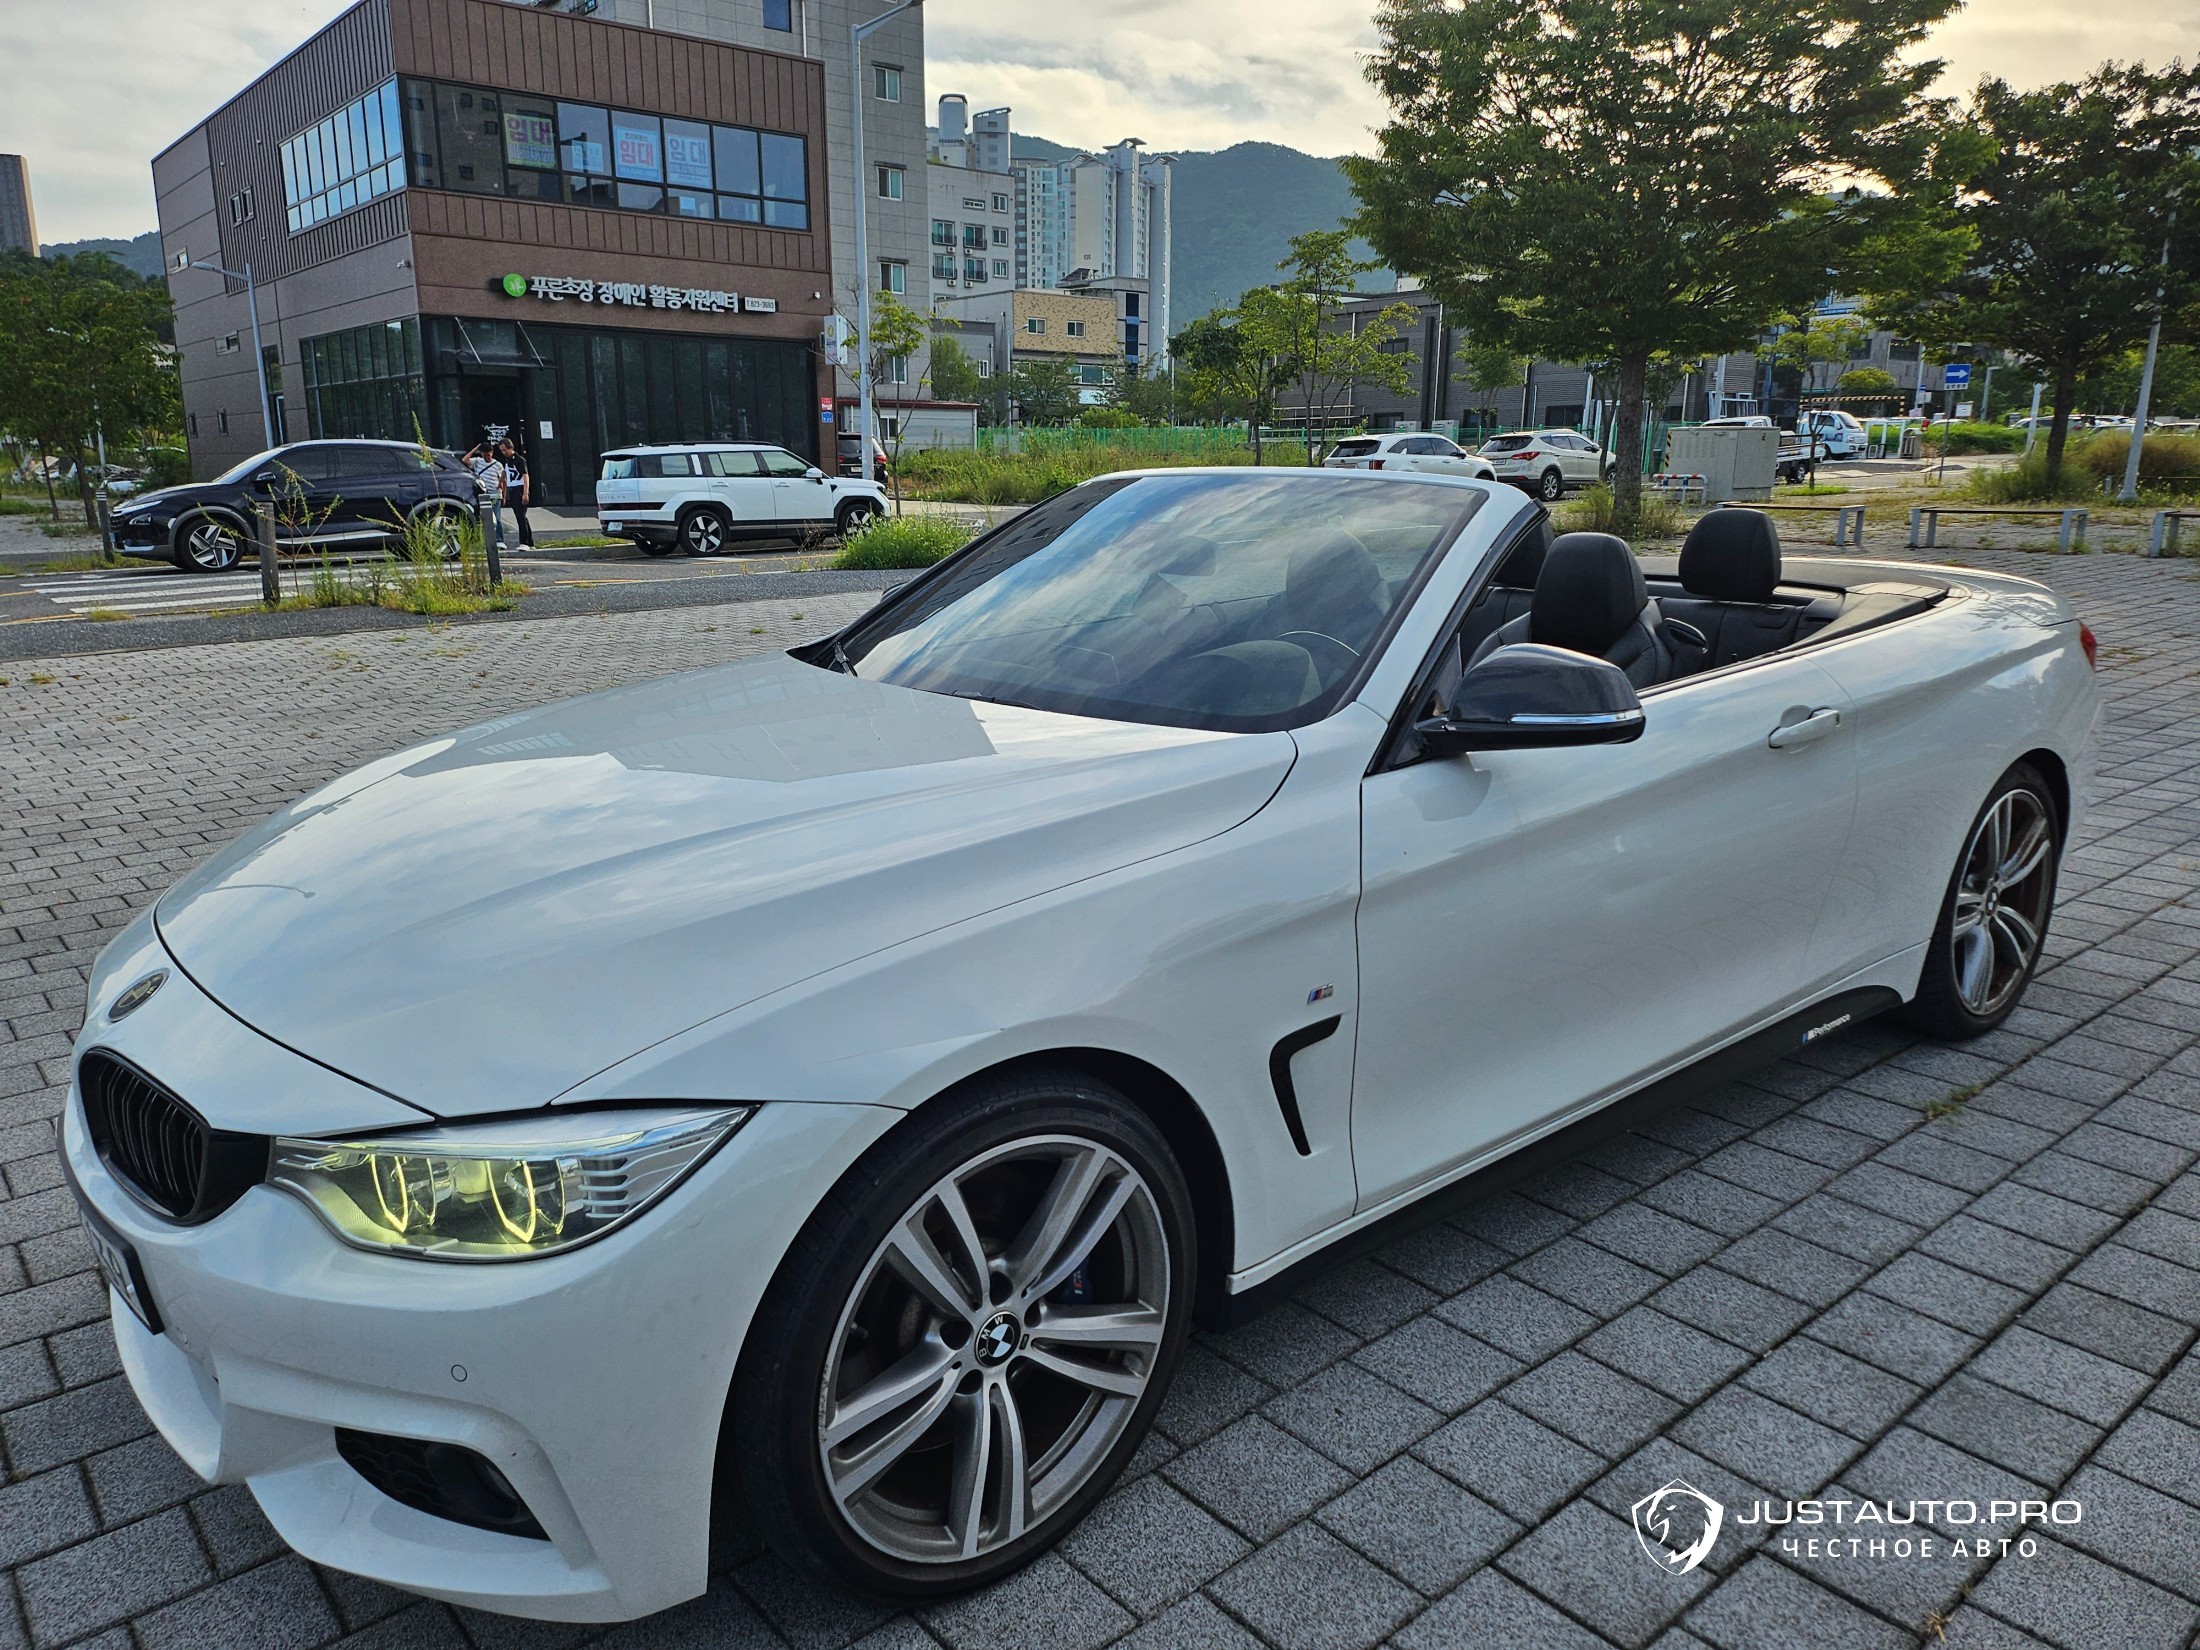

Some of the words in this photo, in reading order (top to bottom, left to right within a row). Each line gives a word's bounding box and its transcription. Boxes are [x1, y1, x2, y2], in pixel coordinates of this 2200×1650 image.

[507, 118, 552, 145] 임대
[620, 140, 654, 167] 임대
[670, 138, 707, 165] 임대
[530, 276, 596, 303] 푸른초장
[597, 281, 646, 307] 장애인
[648, 284, 739, 314] 활동지원센터
